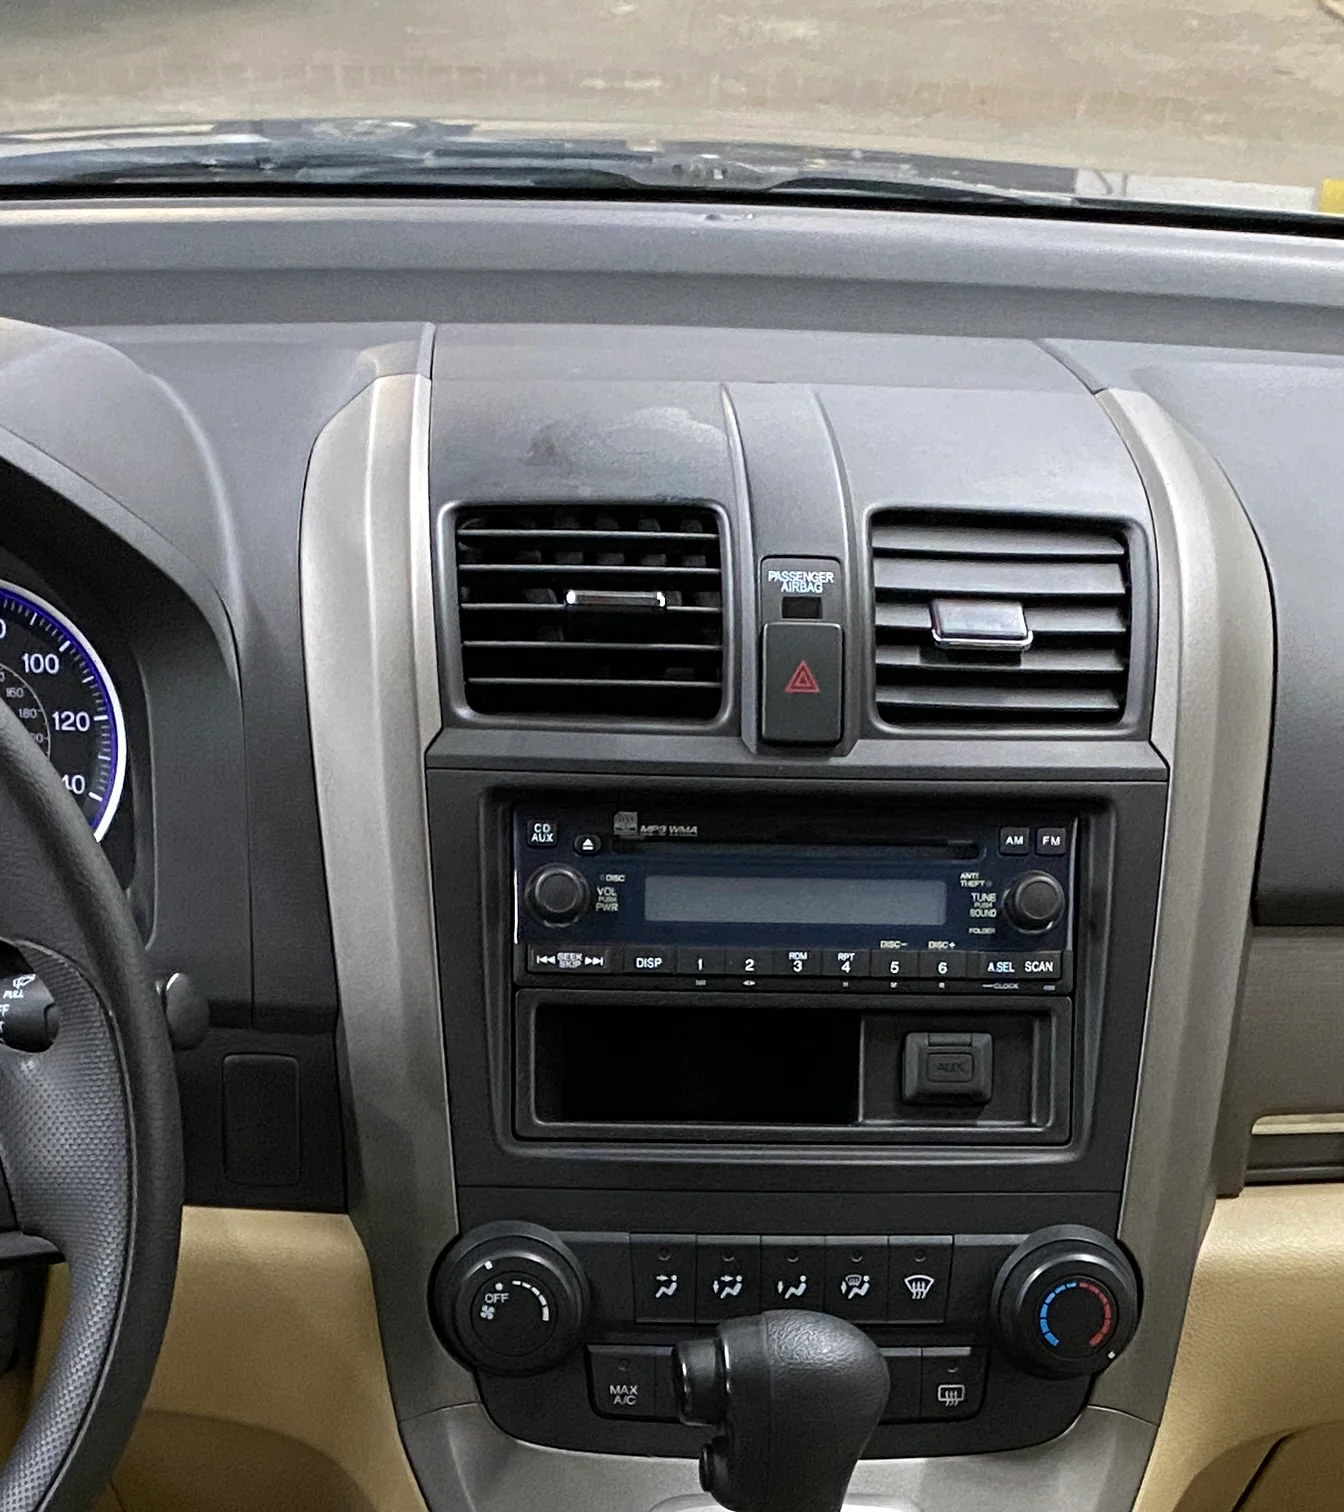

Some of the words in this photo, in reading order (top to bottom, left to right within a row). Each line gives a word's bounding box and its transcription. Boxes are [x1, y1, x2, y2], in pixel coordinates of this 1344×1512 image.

[768, 571, 834, 583] PASSENGER
[781, 581, 824, 594] AIRBAG
[21, 652, 60, 674] 100
[52, 711, 90, 732] 120
[534, 823, 551, 833] CD
[640, 825, 668, 834] MP3
[669, 825, 698, 834] WMA
[531, 833, 554, 843] AUX
[1005, 836, 1024, 845] AM
[1042, 836, 1061, 846] FM
[960, 872, 979, 880] ANTI
[597, 886, 617, 896] VOL
[971, 892, 996, 902] TUNE
[596, 902, 618, 912] PWR
[969, 908, 997, 918] SOUND
[837, 952, 855, 961] RPT
[636, 957, 662, 968] DISP
[698, 958, 703, 971] 1
[744, 958, 755, 971] 2
[793, 960, 803, 972] 3
[841, 961, 851, 973] 4
[890, 961, 899, 974] 5
[937, 962, 948, 974] 6
[1024, 960, 1054, 972] SCAN
[937, 1061, 969, 1074] AUX
[484, 1293, 509, 1304] OFF
[609, 1385, 638, 1396] MAX
[613, 1395, 637, 1406] A/C
